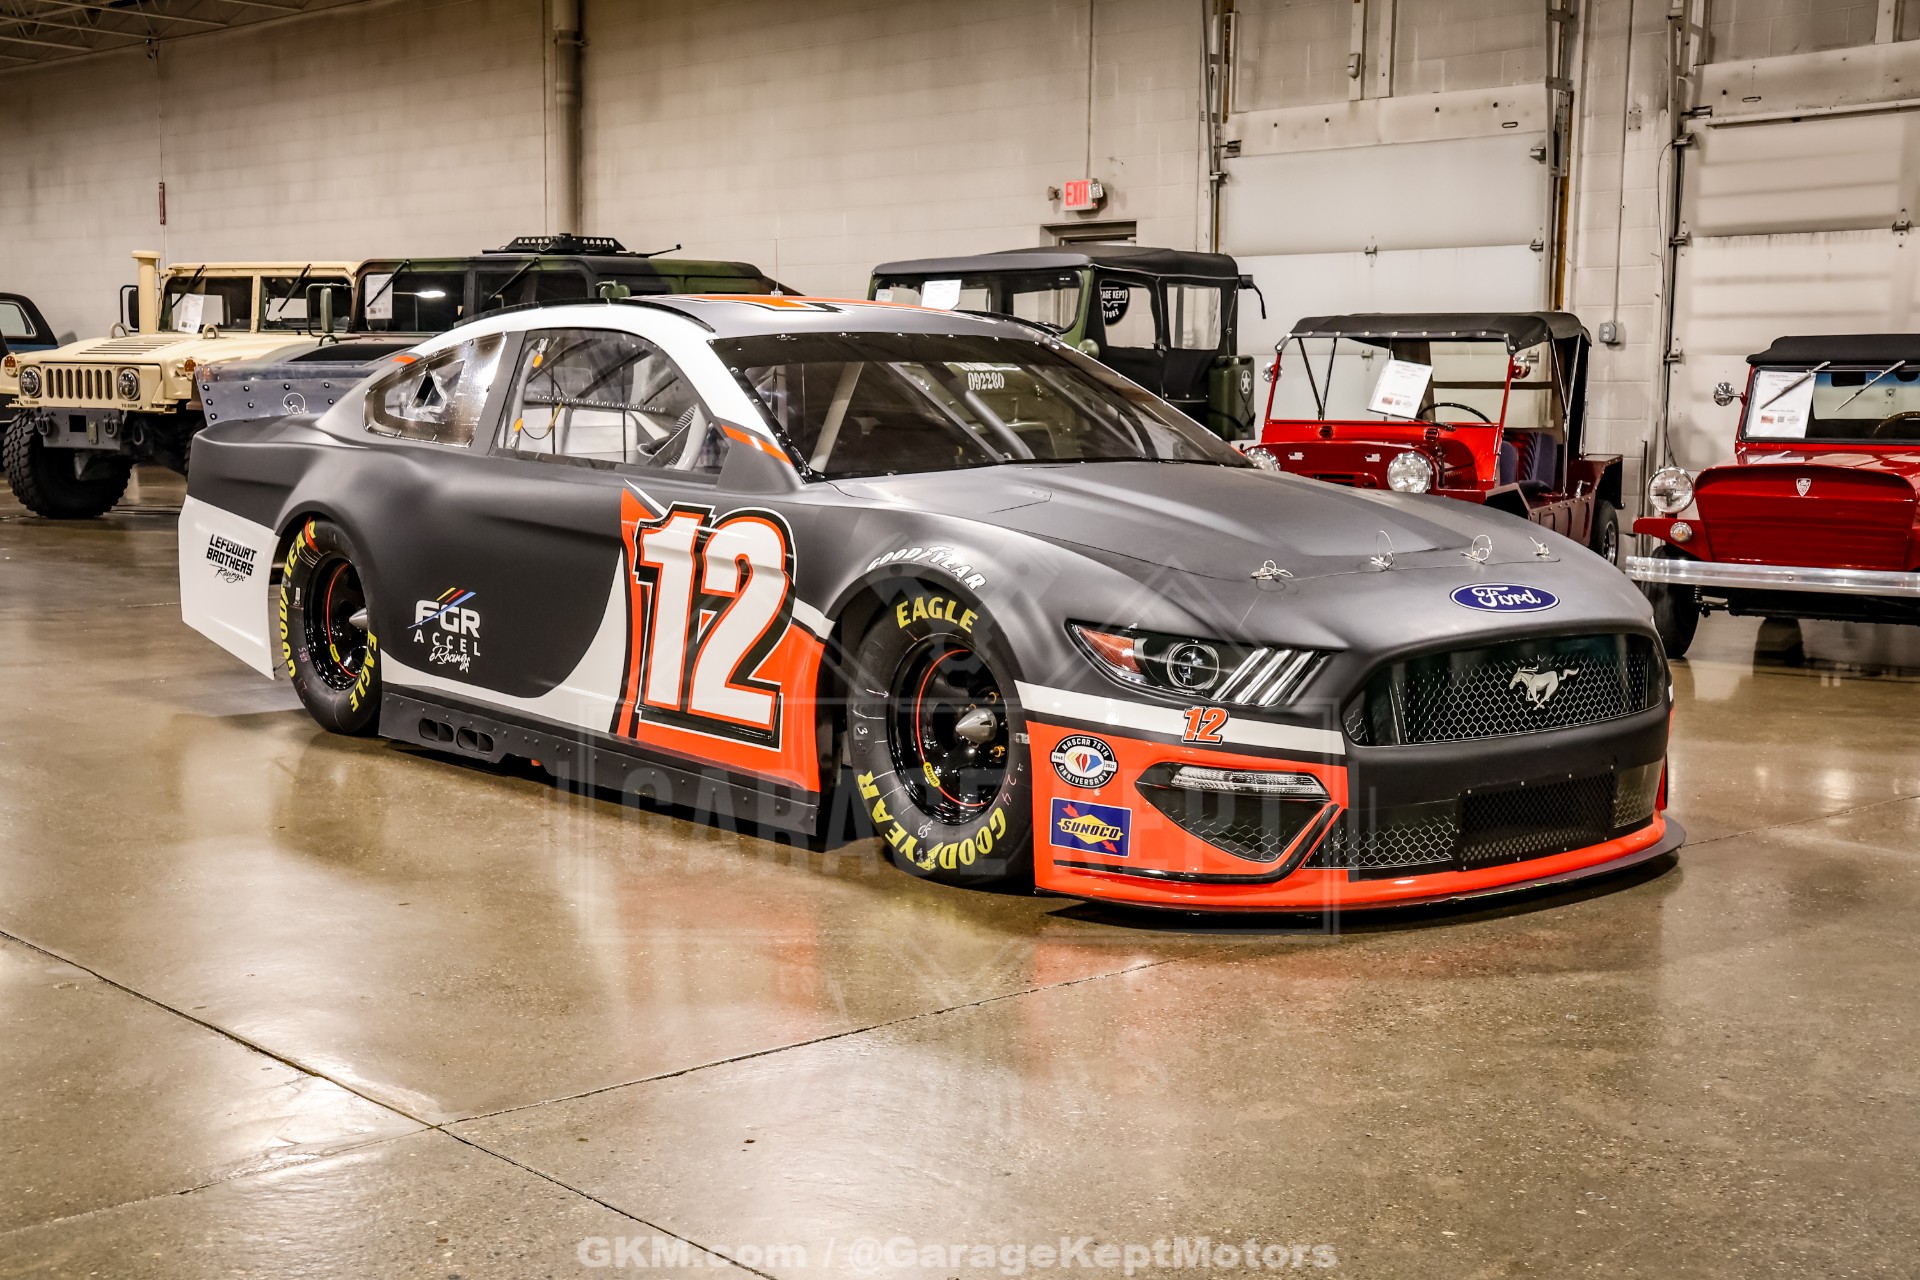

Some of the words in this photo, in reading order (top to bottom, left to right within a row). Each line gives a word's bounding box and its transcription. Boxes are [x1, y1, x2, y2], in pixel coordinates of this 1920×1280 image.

[1065, 180, 1089, 206] EXIT
[1113, 290, 1125, 299] KEPT
[206, 546, 255, 576] BROTHERS
[209, 533, 258, 562] LEFCOURT
[866, 546, 987, 591] GOODYEAR
[1471, 586, 1541, 607] Ford
[414, 599, 481, 639] FGR
[636, 504, 796, 743] 12
[896, 596, 979, 633] EAGLE
[413, 629, 481, 657] ACCEL
[349, 630, 378, 712] EAGLE
[1182, 706, 1229, 745] 12
[1061, 738, 1091, 751] NASCAR
[1092, 740, 1110, 757] 75TH
[1058, 764, 1108, 786] ANNIVERSARY
[857, 770, 1006, 871] GOODYEAR
[1061, 819, 1120, 839] SUNOCO
